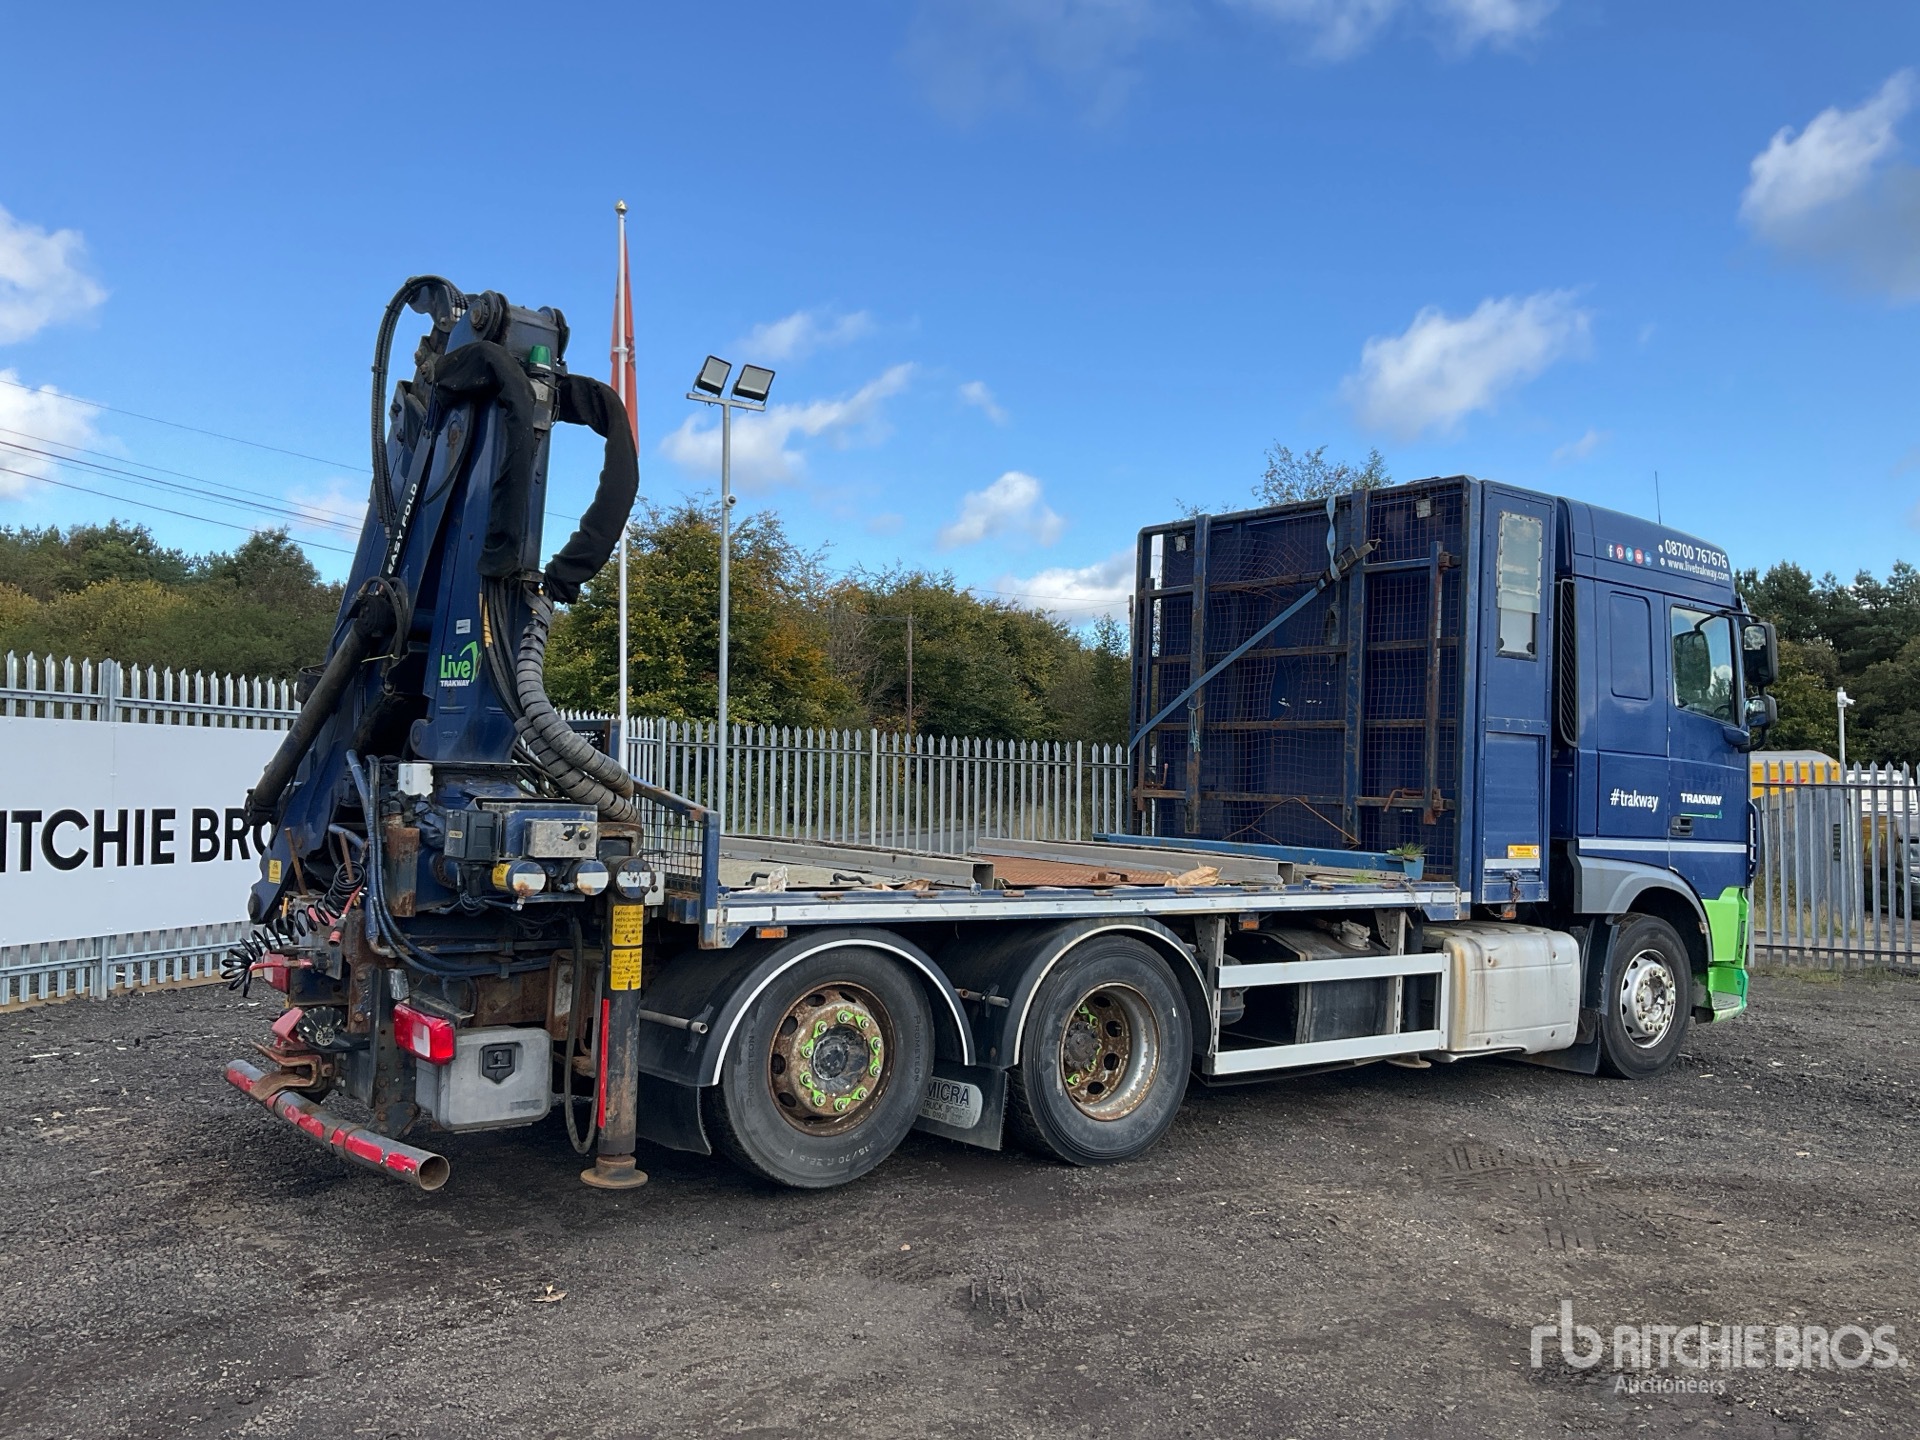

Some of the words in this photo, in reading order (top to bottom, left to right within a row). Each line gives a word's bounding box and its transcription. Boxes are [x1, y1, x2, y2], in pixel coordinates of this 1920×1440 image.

[387, 530, 403, 575] EASY
[401, 483, 417, 528] FOLD
[1665, 539, 1694, 560] 08700
[1695, 547, 1728, 569] 767676
[1667, 559, 1730, 582] www.livetrakway.com
[440, 654, 471, 679] Live
[440, 679, 470, 687] TRAKWAY
[1610, 788, 1659, 813] #trakway
[1680, 792, 1723, 805] TRAKWAY
[913, 1015, 921, 1082] PROMETEON
[746, 1035, 755, 1108] PROMETEON
